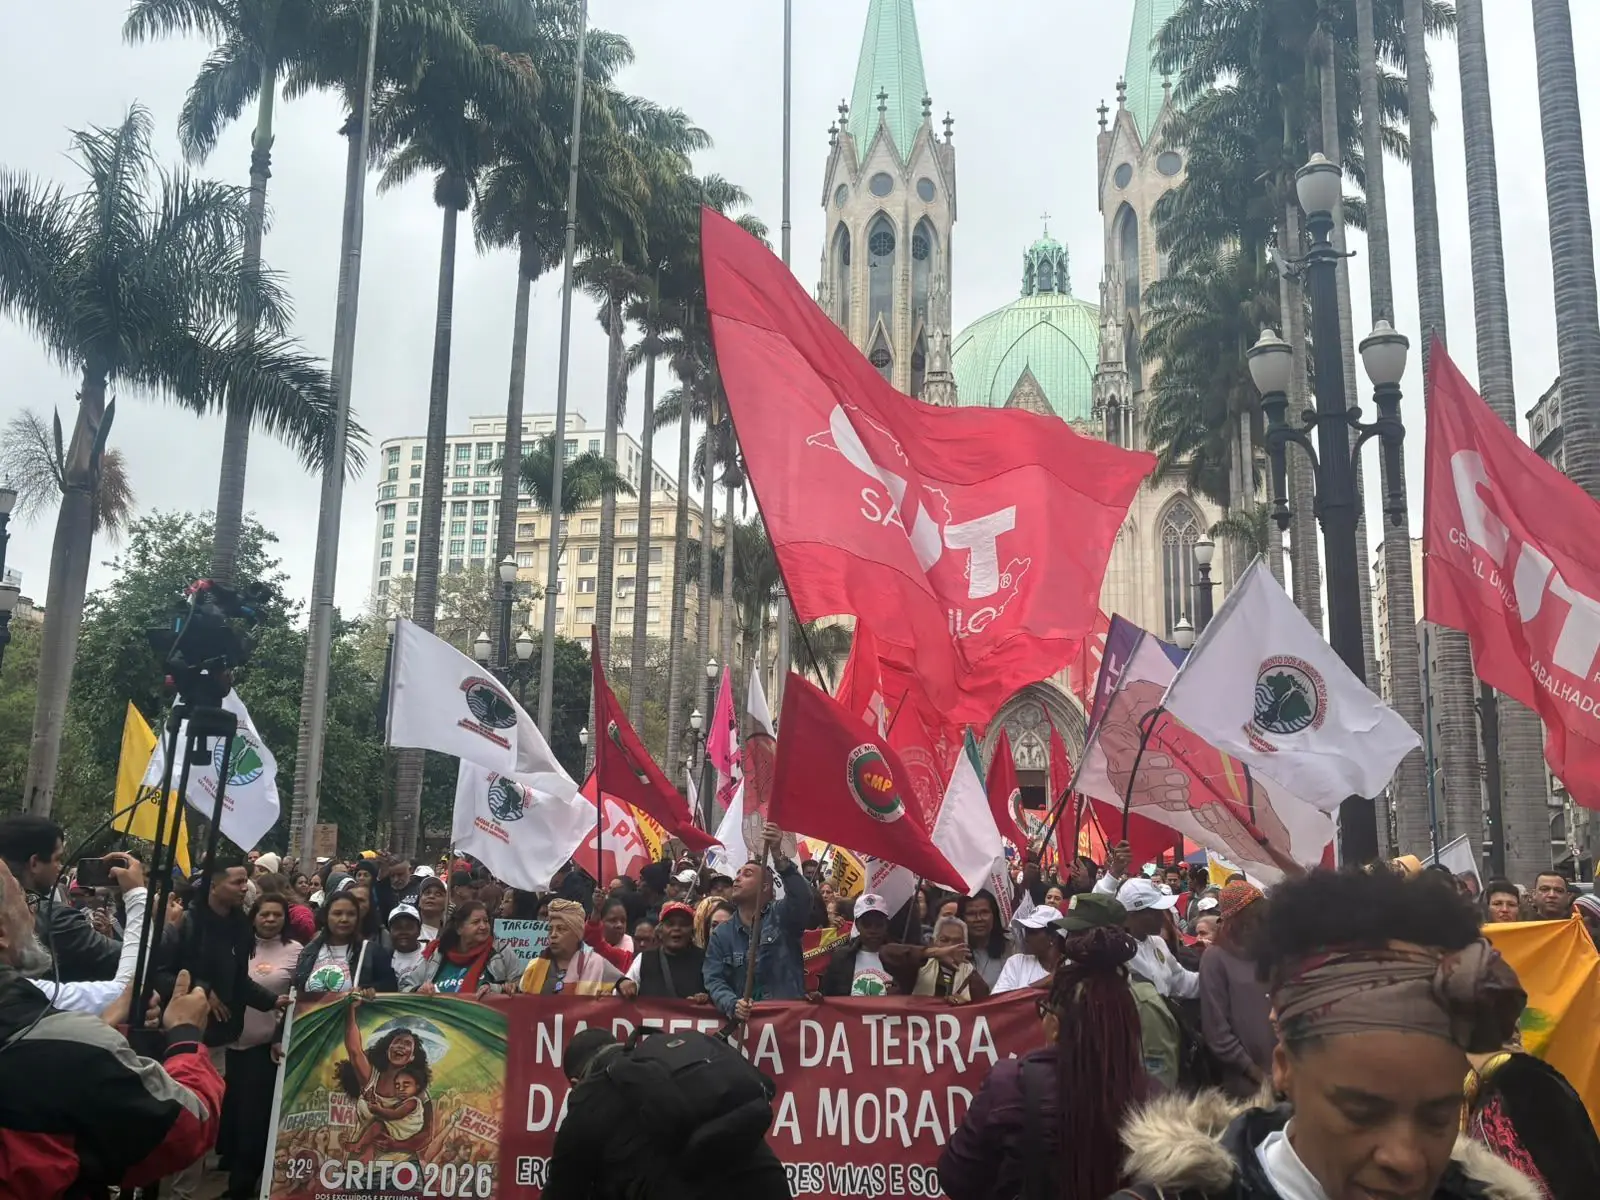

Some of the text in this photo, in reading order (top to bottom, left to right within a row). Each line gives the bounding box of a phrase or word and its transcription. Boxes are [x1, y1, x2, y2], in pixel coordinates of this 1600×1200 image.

[863, 773, 893, 792] CMP
[612, 820, 641, 851] PT
[535, 1014, 588, 1068] N
[800, 1019, 853, 1074] DA
[331, 1105, 356, 1124] NÃ
[817, 1086, 973, 1148] MORAD
[320, 1159, 418, 1191] GRITO
[423, 1163, 492, 1198] 2026
[783, 1161, 825, 1198] RES
[827, 1162, 886, 1198] VIVAS
[890, 1164, 904, 1196] E
[908, 1164, 947, 1197] SO
